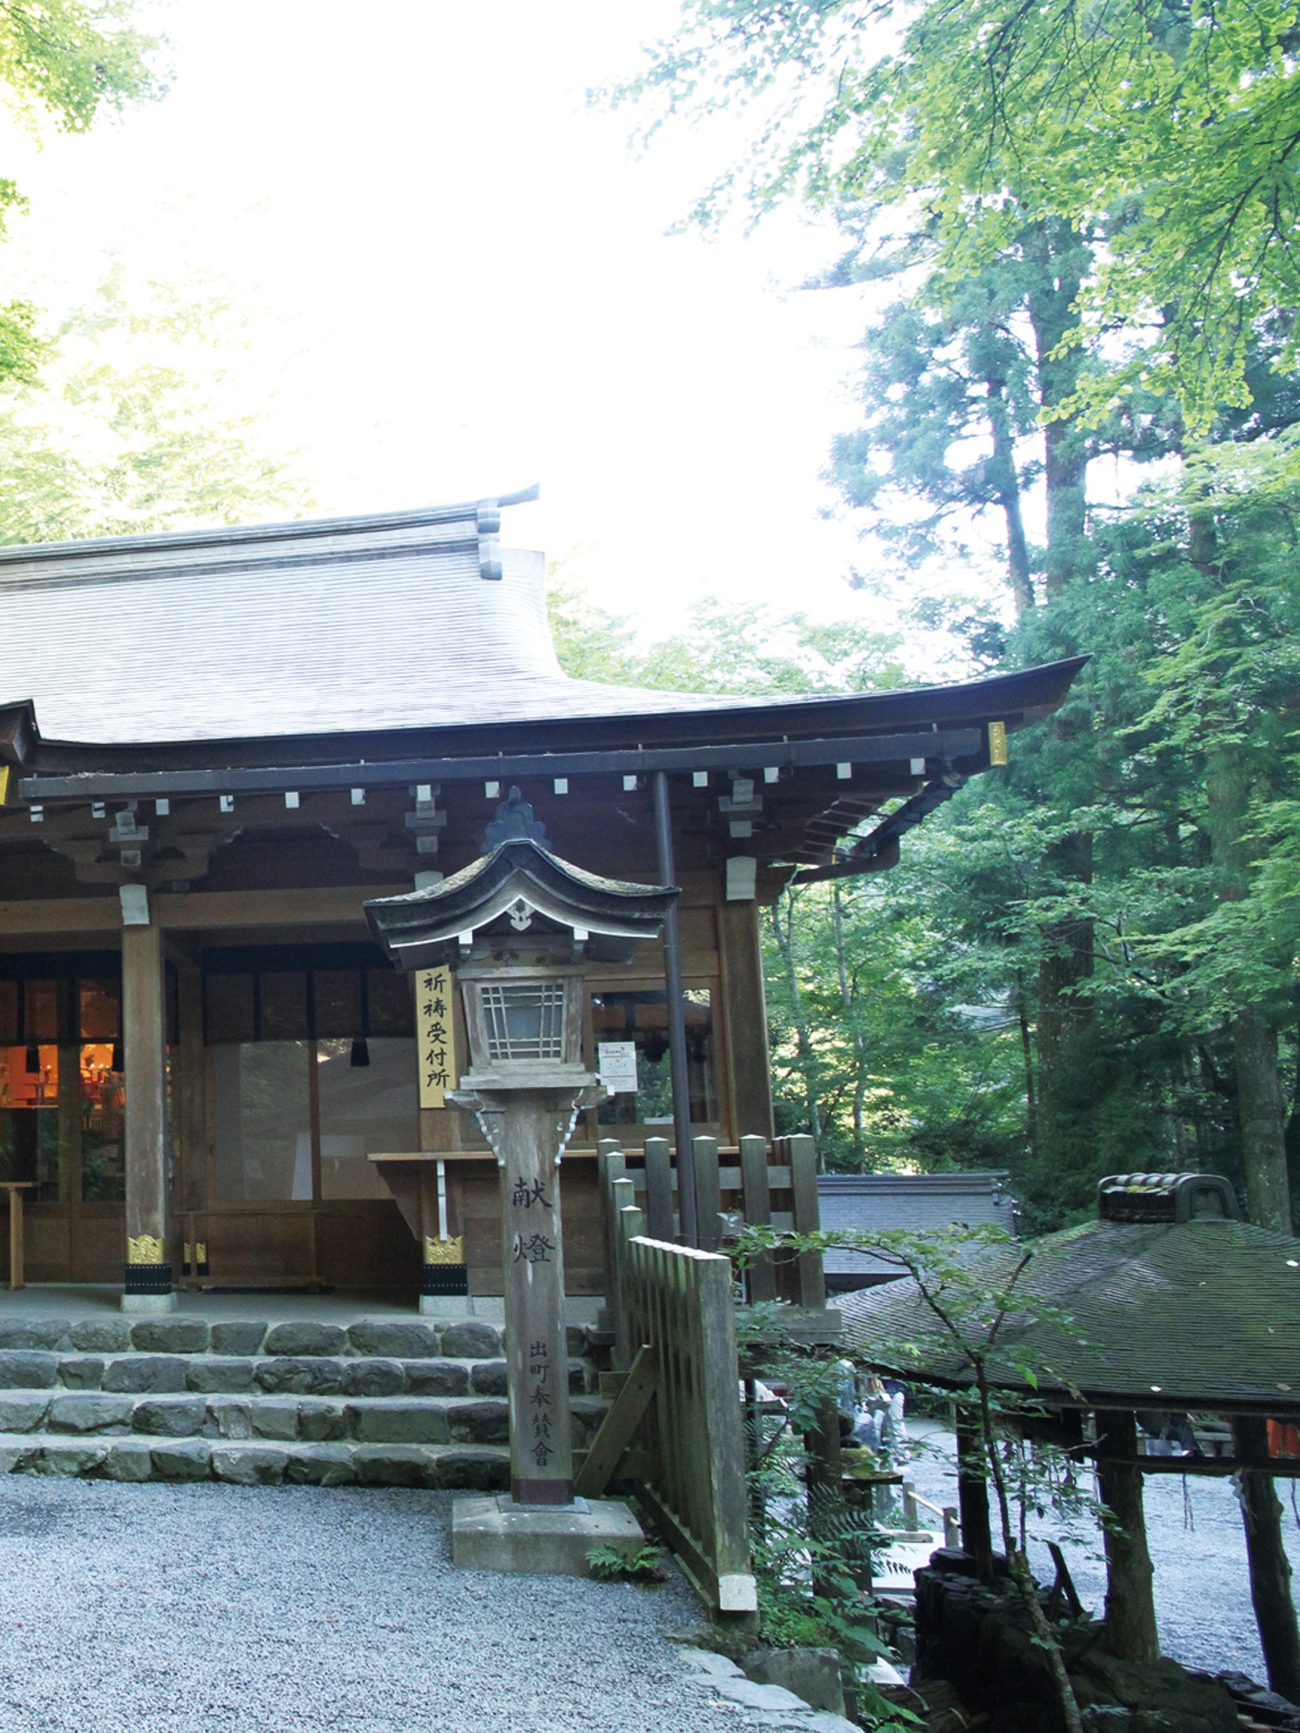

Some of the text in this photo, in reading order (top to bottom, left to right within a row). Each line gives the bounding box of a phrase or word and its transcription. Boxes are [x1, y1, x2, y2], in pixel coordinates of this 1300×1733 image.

[423, 973, 450, 1088] 祈祷受付所
[513, 1177, 555, 1263] 献燈
